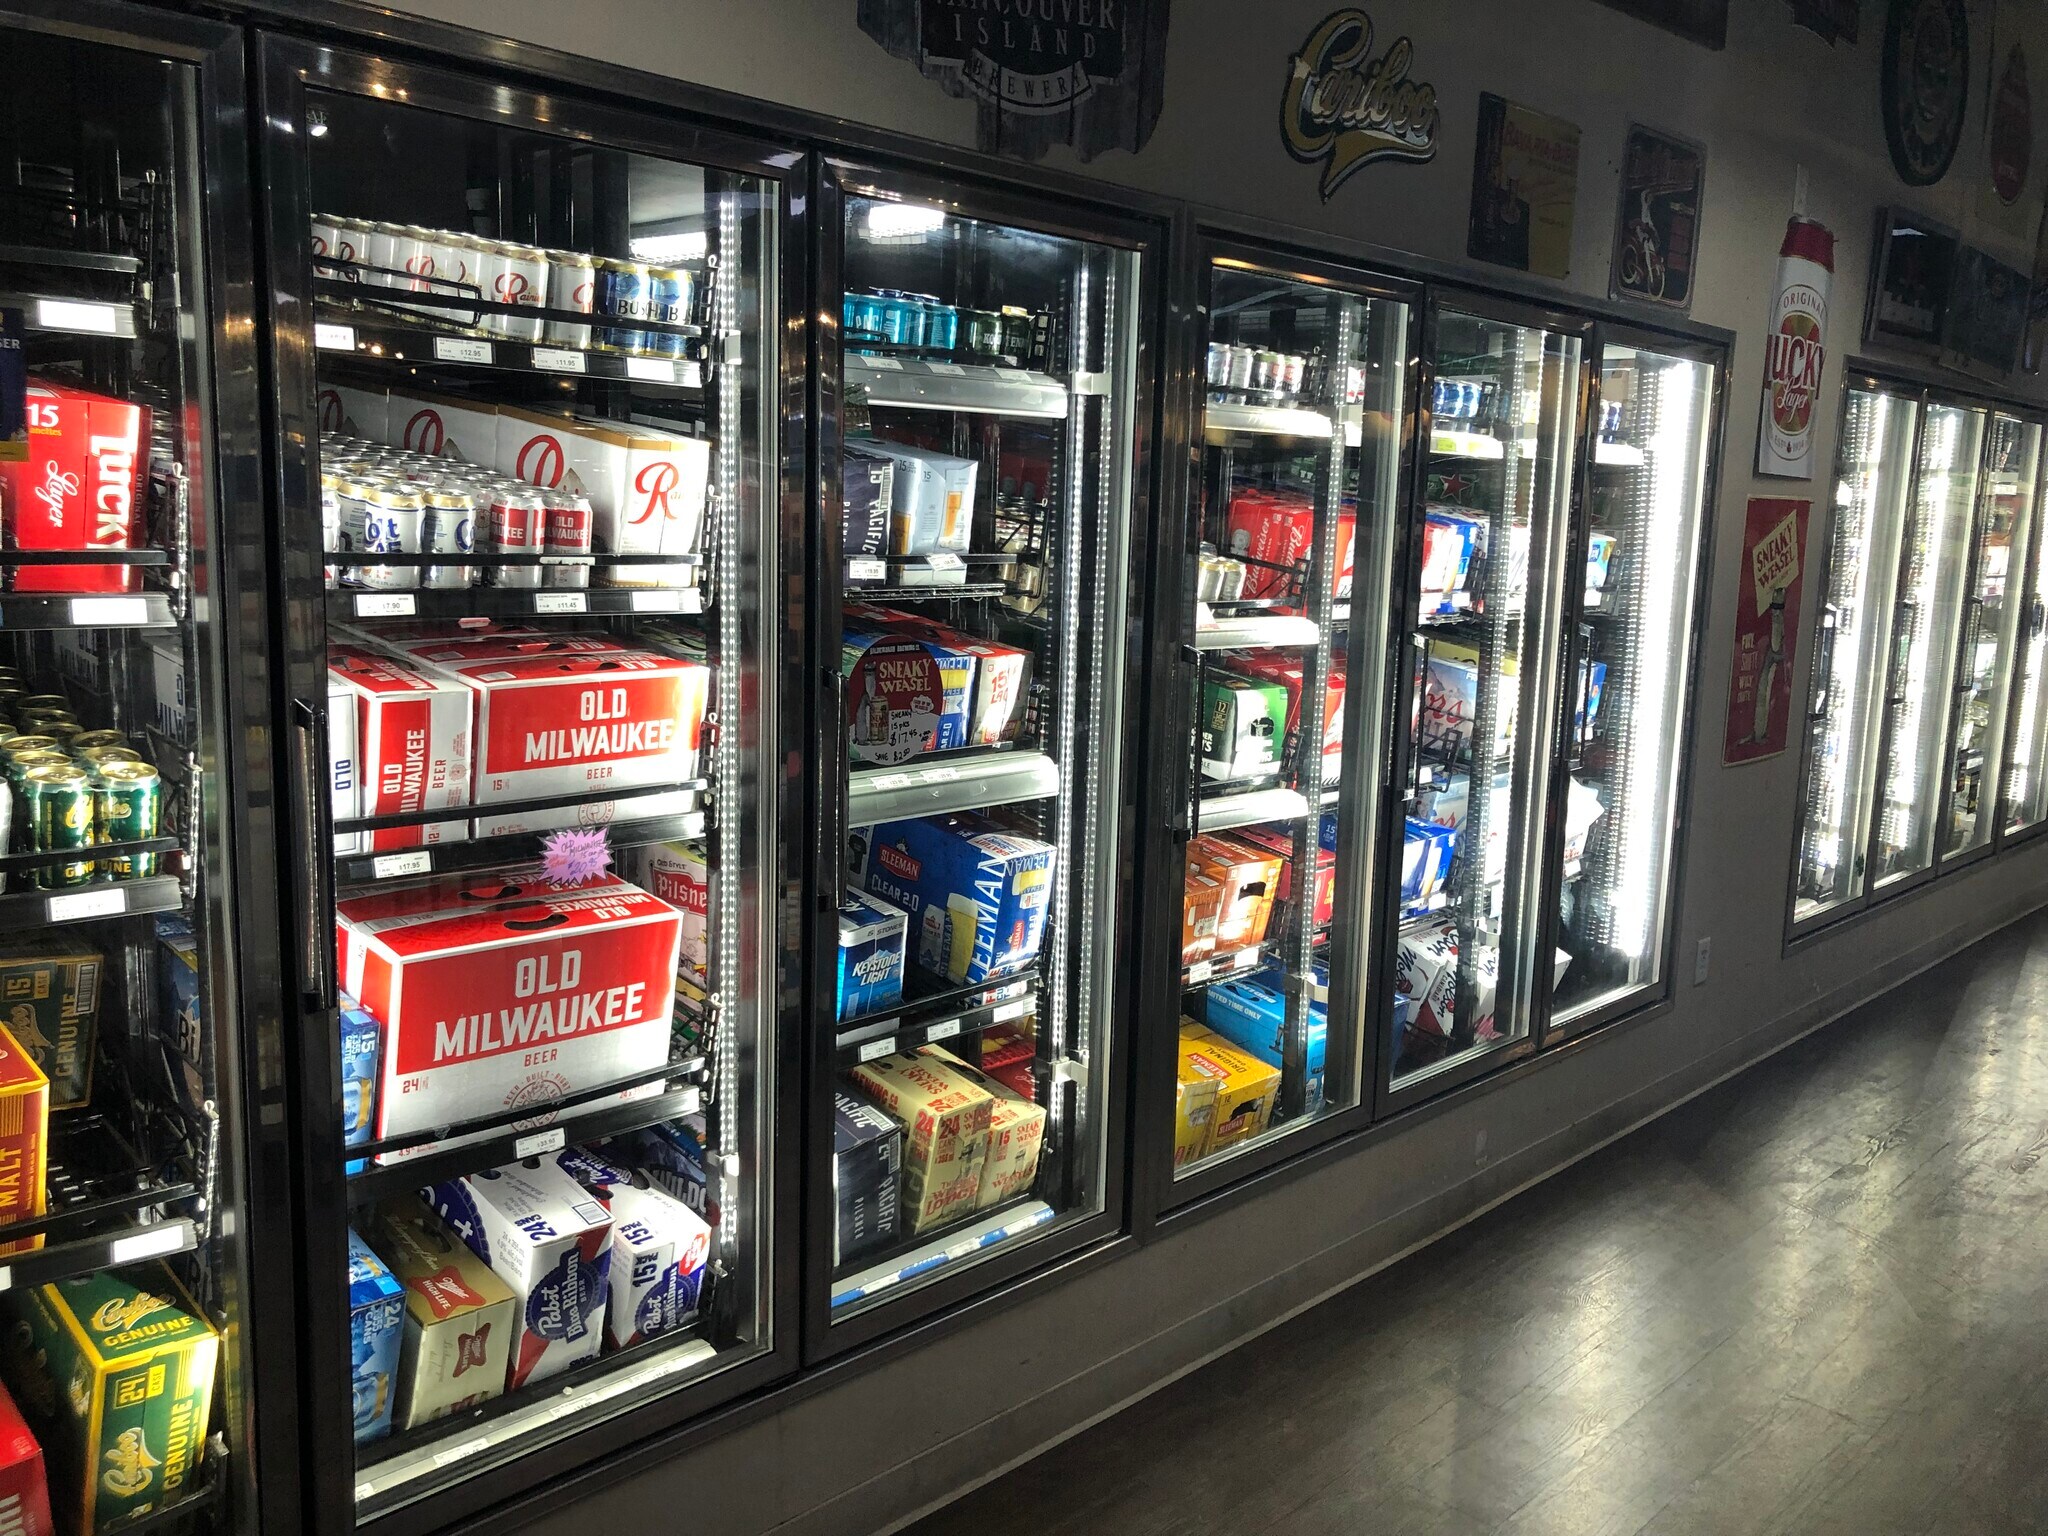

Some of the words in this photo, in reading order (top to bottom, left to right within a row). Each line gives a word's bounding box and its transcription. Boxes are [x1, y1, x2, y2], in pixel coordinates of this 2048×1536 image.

[954, 14, 1097, 58] ISLAND
[971, 56, 1084, 97] BREWERY
[1776, 377, 1809, 424] Lager
[28, 403, 60, 427] 15
[30, 427, 62, 437] anettes
[923, 470, 931, 480] 15
[35, 459, 80, 528] Lager
[555, 516, 574, 527] OLD
[861, 499, 884, 556] PACIFIC
[1243, 517, 1270, 595] Buweiser
[1756, 520, 1794, 573] SNEAKY
[1757, 546, 1796, 589] WEASEL
[879, 658, 932, 679] SNEAKY
[878, 677, 932, 694] WEASEL
[579, 687, 628, 722] OLD
[891, 710, 912, 720] SNEAKY
[1218, 702, 1227, 713] 12
[524, 719, 674, 764] MILWAUKEE
[335, 759, 351, 791] OLD
[382, 763, 403, 795] OLD
[432, 759, 447, 790] BEER
[492, 779, 503, 791] 15
[586, 766, 613, 780] BEER
[428, 832, 440, 844] 12
[399, 861, 421, 870] $17.95
[879, 848, 920, 877] SLEEMAN
[545, 893, 653, 913] MILWAUKEE
[658, 874, 707, 908] Pilsne
[871, 873, 901, 902] CLEAR
[902, 892, 920, 912] 2.0
[593, 904, 632, 919] OLD
[966, 850, 1007, 986] LEEMAN
[514, 949, 582, 999] OLD
[852, 950, 901, 977] KEYSTONE
[7, 976, 32, 997] 15
[860, 969, 890, 987] LIGHT
[432, 982, 646, 1062] MILWAUKEE
[1228, 1000, 1244, 1012] TIME
[1244, 1006, 1262, 1021] ONLY
[54, 993, 78, 1078] GENUINE
[361, 1031, 376, 1054] 15
[524, 1048, 557, 1068] BEER
[1191, 1053, 1229, 1080] SLEEMAN
[1205, 1046, 1248, 1074] ORIGINAL
[402, 1078, 420, 1094] 24
[524, 1070, 550, 1084] BUILT
[910, 1062, 949, 1091] WEASEL
[926, 1098, 954, 1113] 24
[1224, 1094, 1232, 1104] 12
[914, 1109, 935, 1137] 24
[939, 1114, 961, 1140] 24
[999, 1129, 1012, 1147] 15
[877, 1142, 888, 1162] 24
[854, 1196, 864, 1240] PILSNER
[876, 1175, 896, 1234] PACIFIC
[514, 1213, 543, 1228] CANS
[522, 1220, 558, 1241] 24
[617, 1220, 643, 1234] PACK
[623, 1227, 655, 1246] 15
[561, 1251, 580, 1311] Ribbon
[632, 1262, 658, 1288] 15
[422, 1279, 441, 1298] HIGH
[435, 1291, 452, 1310] LIFE
[384, 1302, 401, 1329] 24
[537, 1284, 563, 1336] Pabst
[566, 1308, 584, 1339] Blue
[643, 1295, 662, 1335] Pabst
[103, 1315, 195, 1347] GENUINE
[363, 1311, 374, 1345] CANS
[121, 1379, 146, 1406] 24
[151, 1371, 163, 1393] CASE
[163, 1398, 194, 1490] GENUINE
